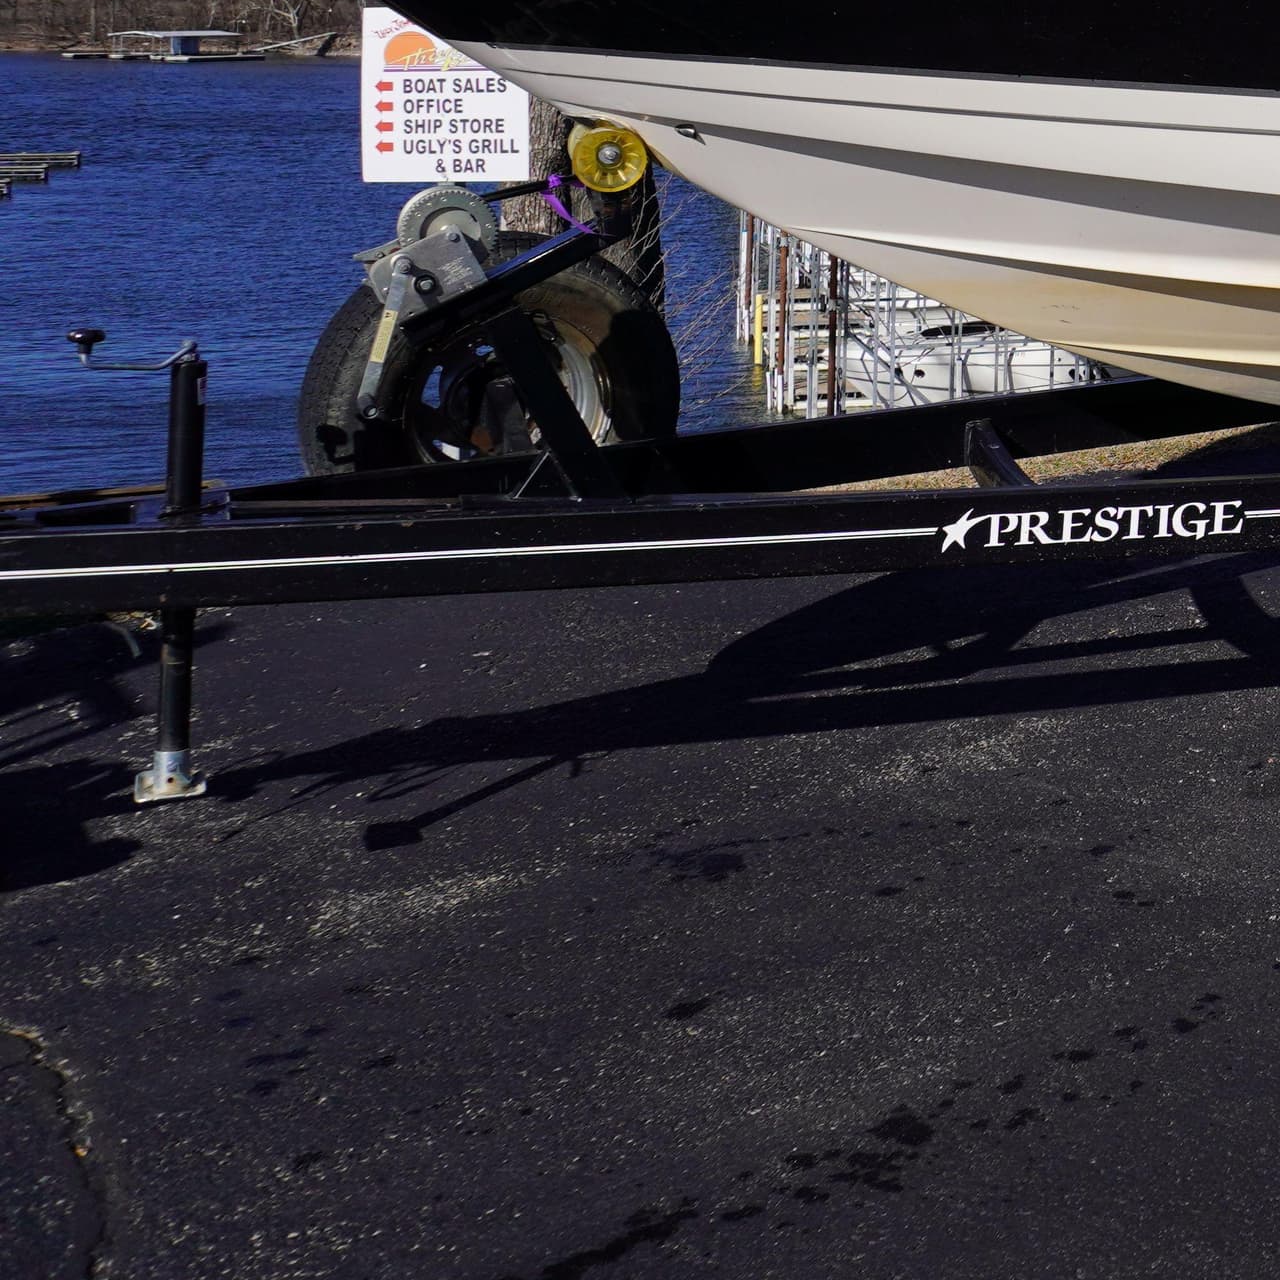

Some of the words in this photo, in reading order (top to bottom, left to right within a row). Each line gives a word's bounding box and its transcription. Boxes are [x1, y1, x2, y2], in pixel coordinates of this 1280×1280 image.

[403, 78, 446, 93] BOAT
[453, 78, 507, 93] SALES
[403, 99, 463, 114] OFFICE
[403, 119, 443, 134] SHIP
[448, 119, 505, 134] STORE
[403, 139, 462, 154] UGLY'S
[468, 139, 520, 154] GRILL
[435, 158, 446, 173] &
[453, 158, 486, 173] BAR
[983, 500, 1243, 548] PRESTIGE
